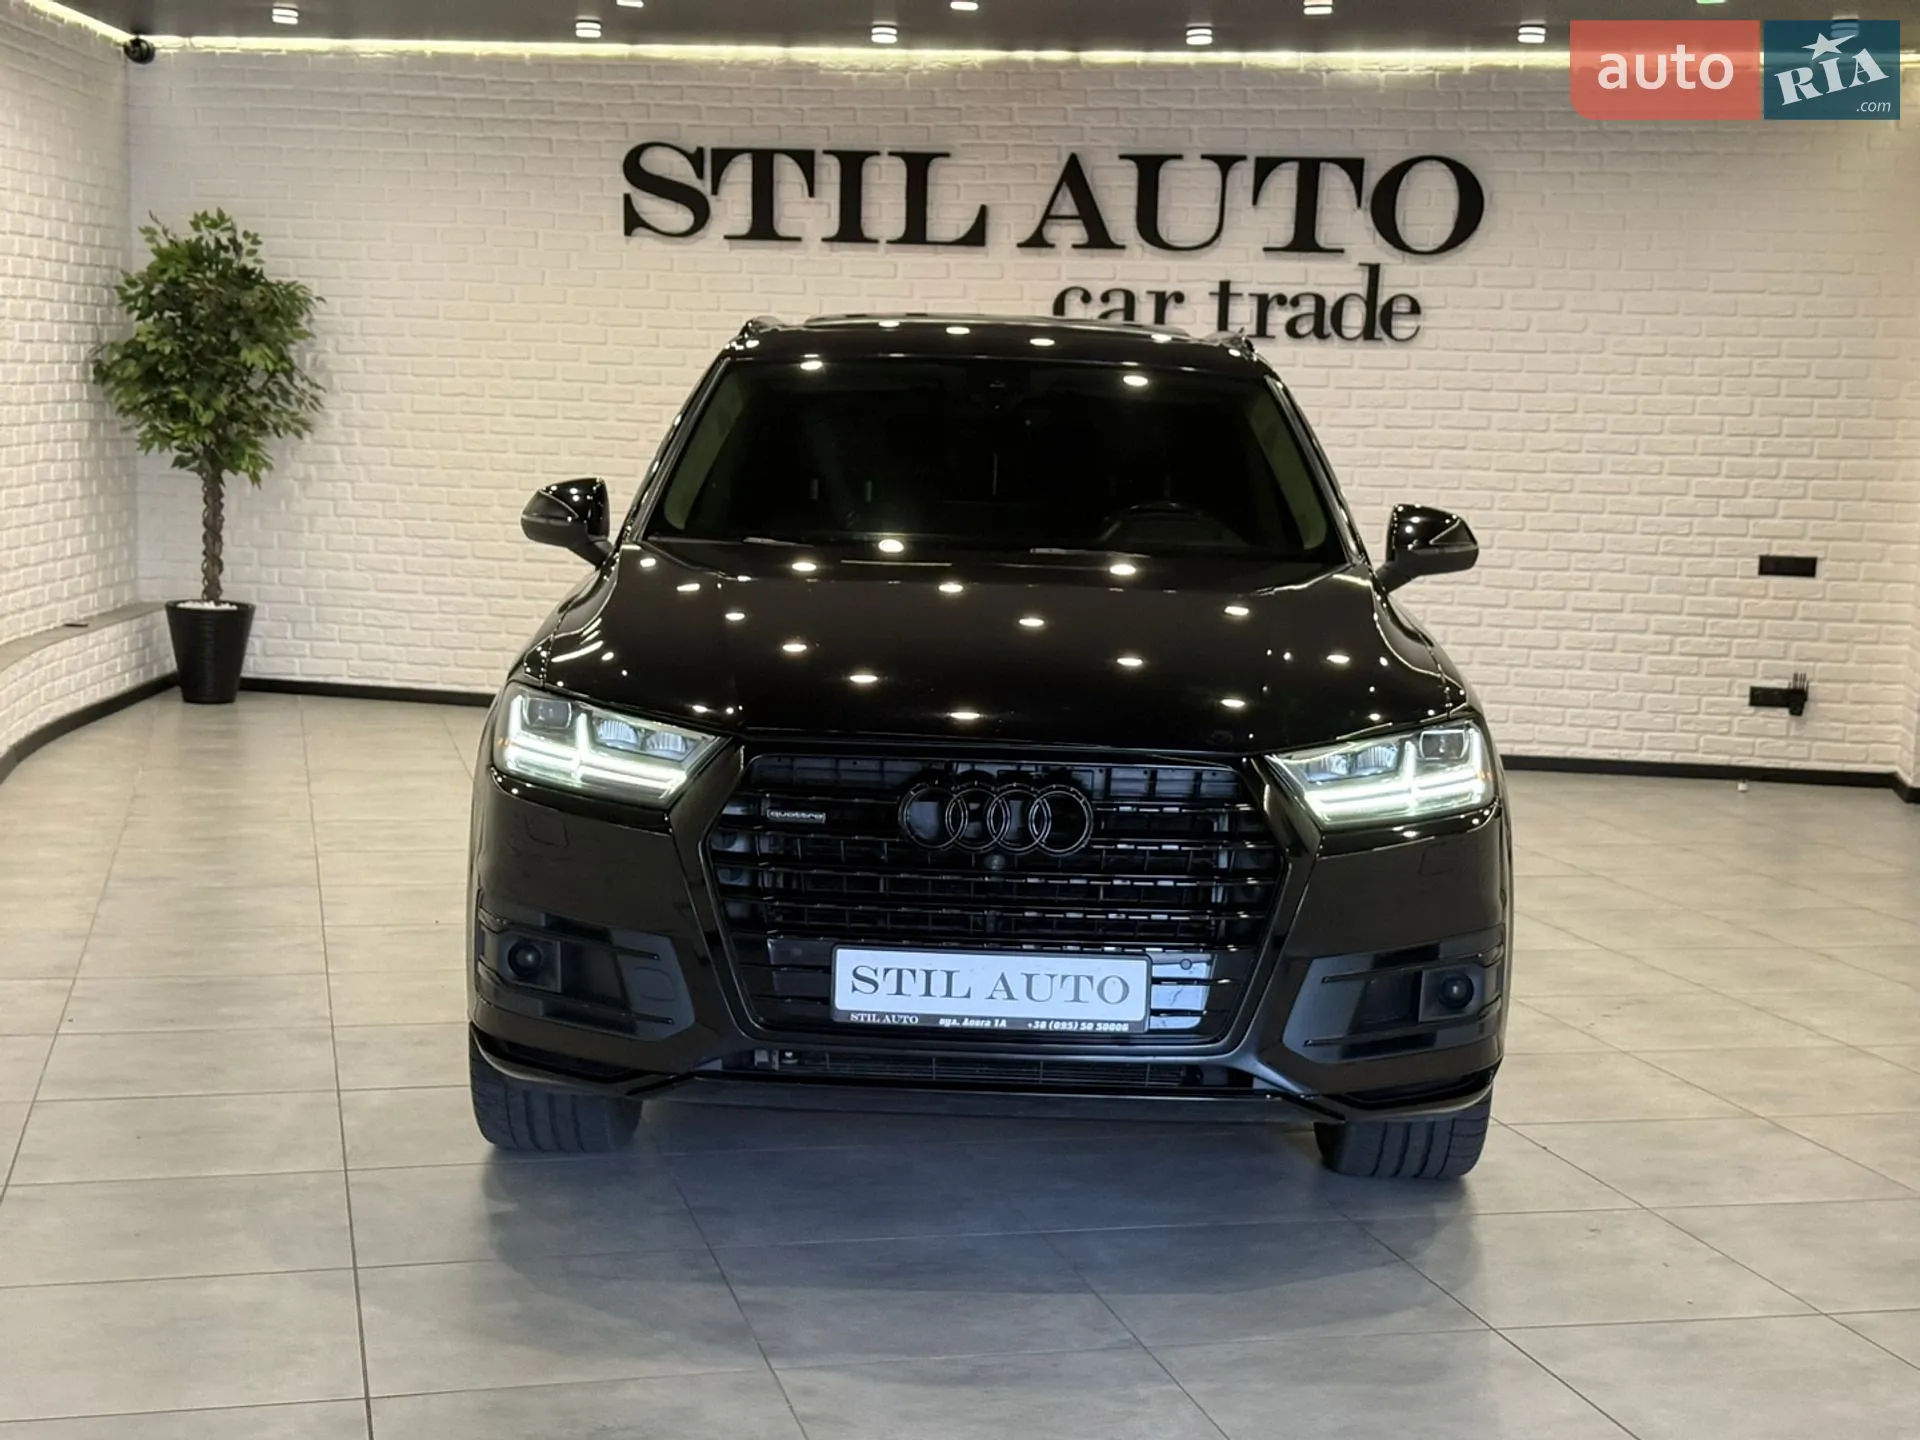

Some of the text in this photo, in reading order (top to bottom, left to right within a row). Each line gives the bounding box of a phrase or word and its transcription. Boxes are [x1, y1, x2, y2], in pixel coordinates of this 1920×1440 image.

[622, 140, 1486, 255] STIL AUTO
[1052, 262, 1422, 342] car trade
[850, 965, 1130, 1005] STIL AUTO
[850, 1013, 919, 1025] STIL AUTO
